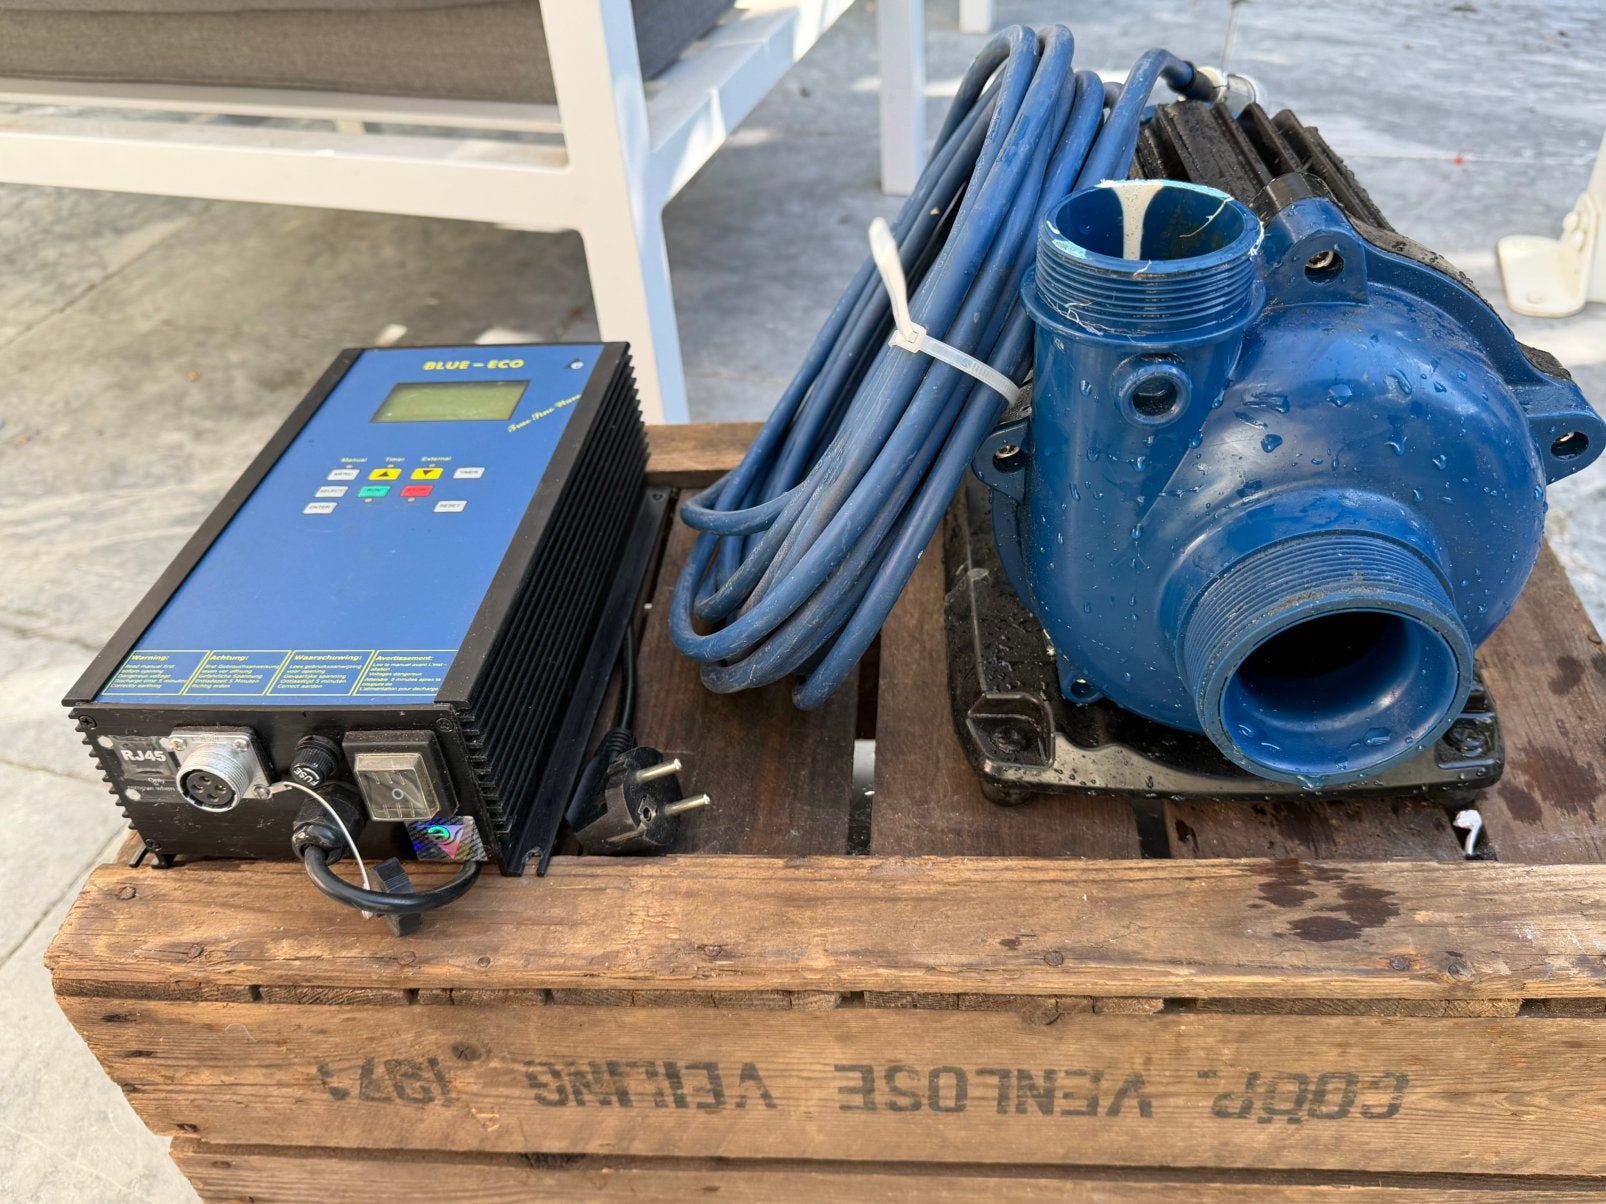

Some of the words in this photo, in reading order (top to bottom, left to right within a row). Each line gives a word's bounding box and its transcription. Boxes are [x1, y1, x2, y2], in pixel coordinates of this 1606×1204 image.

[422, 360, 471, 370] BLUE
[487, 359, 525, 369] ECO
[120, 749, 167, 762] RJ45
[293, 767, 320, 787] FUSE
[523, 1060, 779, 1110] VEILING
[834, 1064, 1153, 1119] VENLOSE
